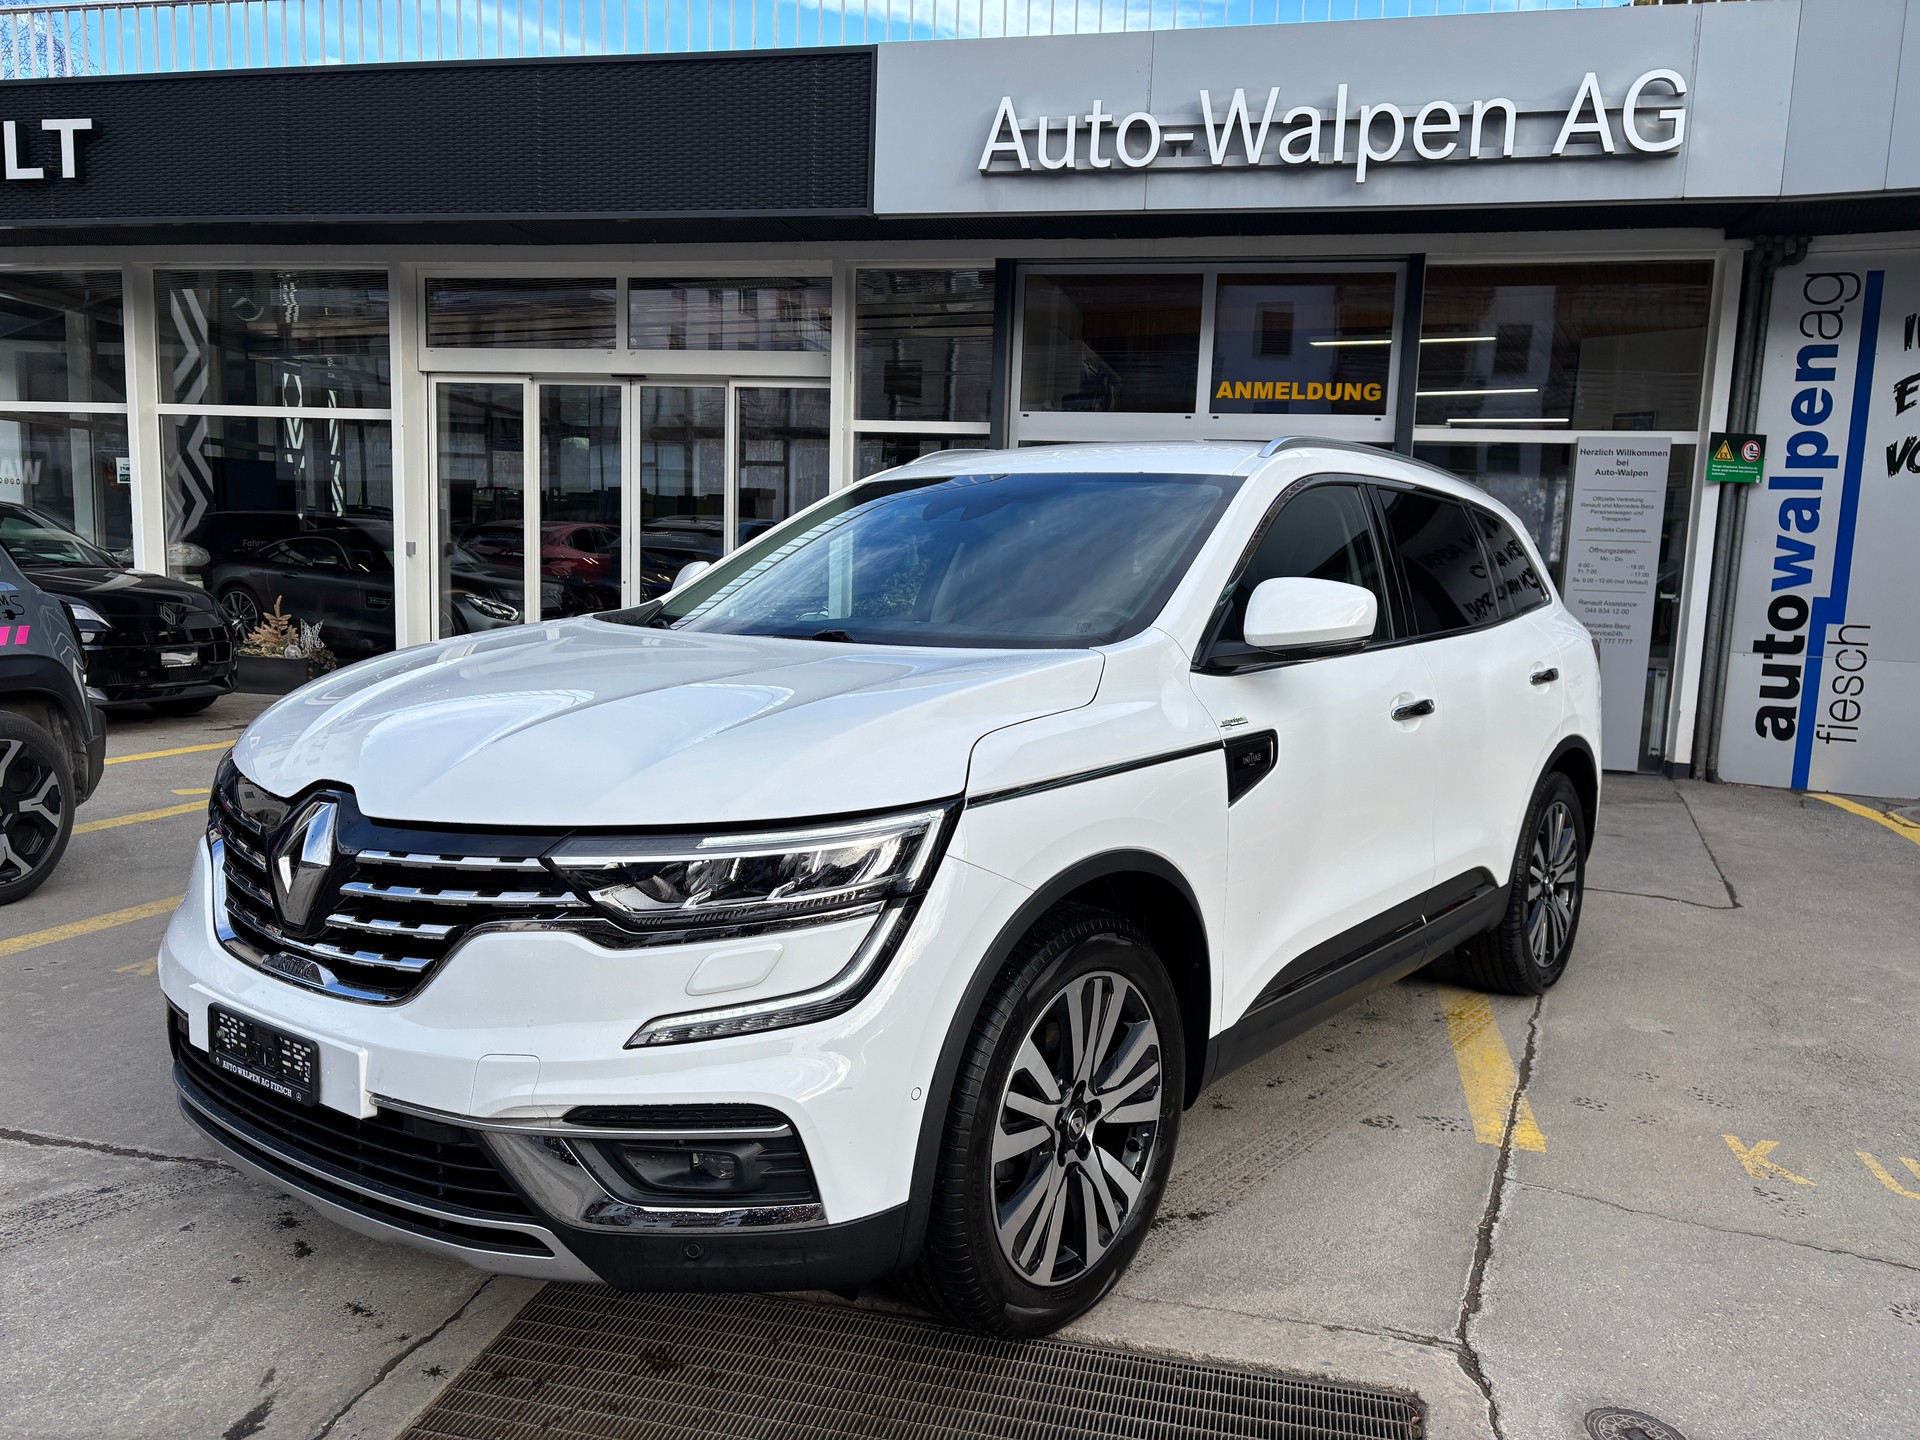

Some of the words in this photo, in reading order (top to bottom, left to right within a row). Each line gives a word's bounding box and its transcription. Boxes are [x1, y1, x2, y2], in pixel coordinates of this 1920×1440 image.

[979, 83, 1517, 184] Auto-Walpen
[1551, 68, 1687, 157] AG
[3, 118, 93, 180] LT
[1215, 380, 1383, 402] ANMELDUNG
[1580, 448, 1614, 457] Herzlich
[1616, 448, 1668, 457] Willkommen
[1616, 459, 1630, 467] bei
[1595, 469, 1649, 478] Auto-Walpen
[1603, 600, 1638, 608] Assistance
[1817, 623, 1872, 744] fiesch
[222, 1060, 237, 1073] AUTO
[237, 1067, 260, 1081] WALPEN
[261, 1076, 270, 1088] AG
[270, 1082, 292, 1097] FIESCH
